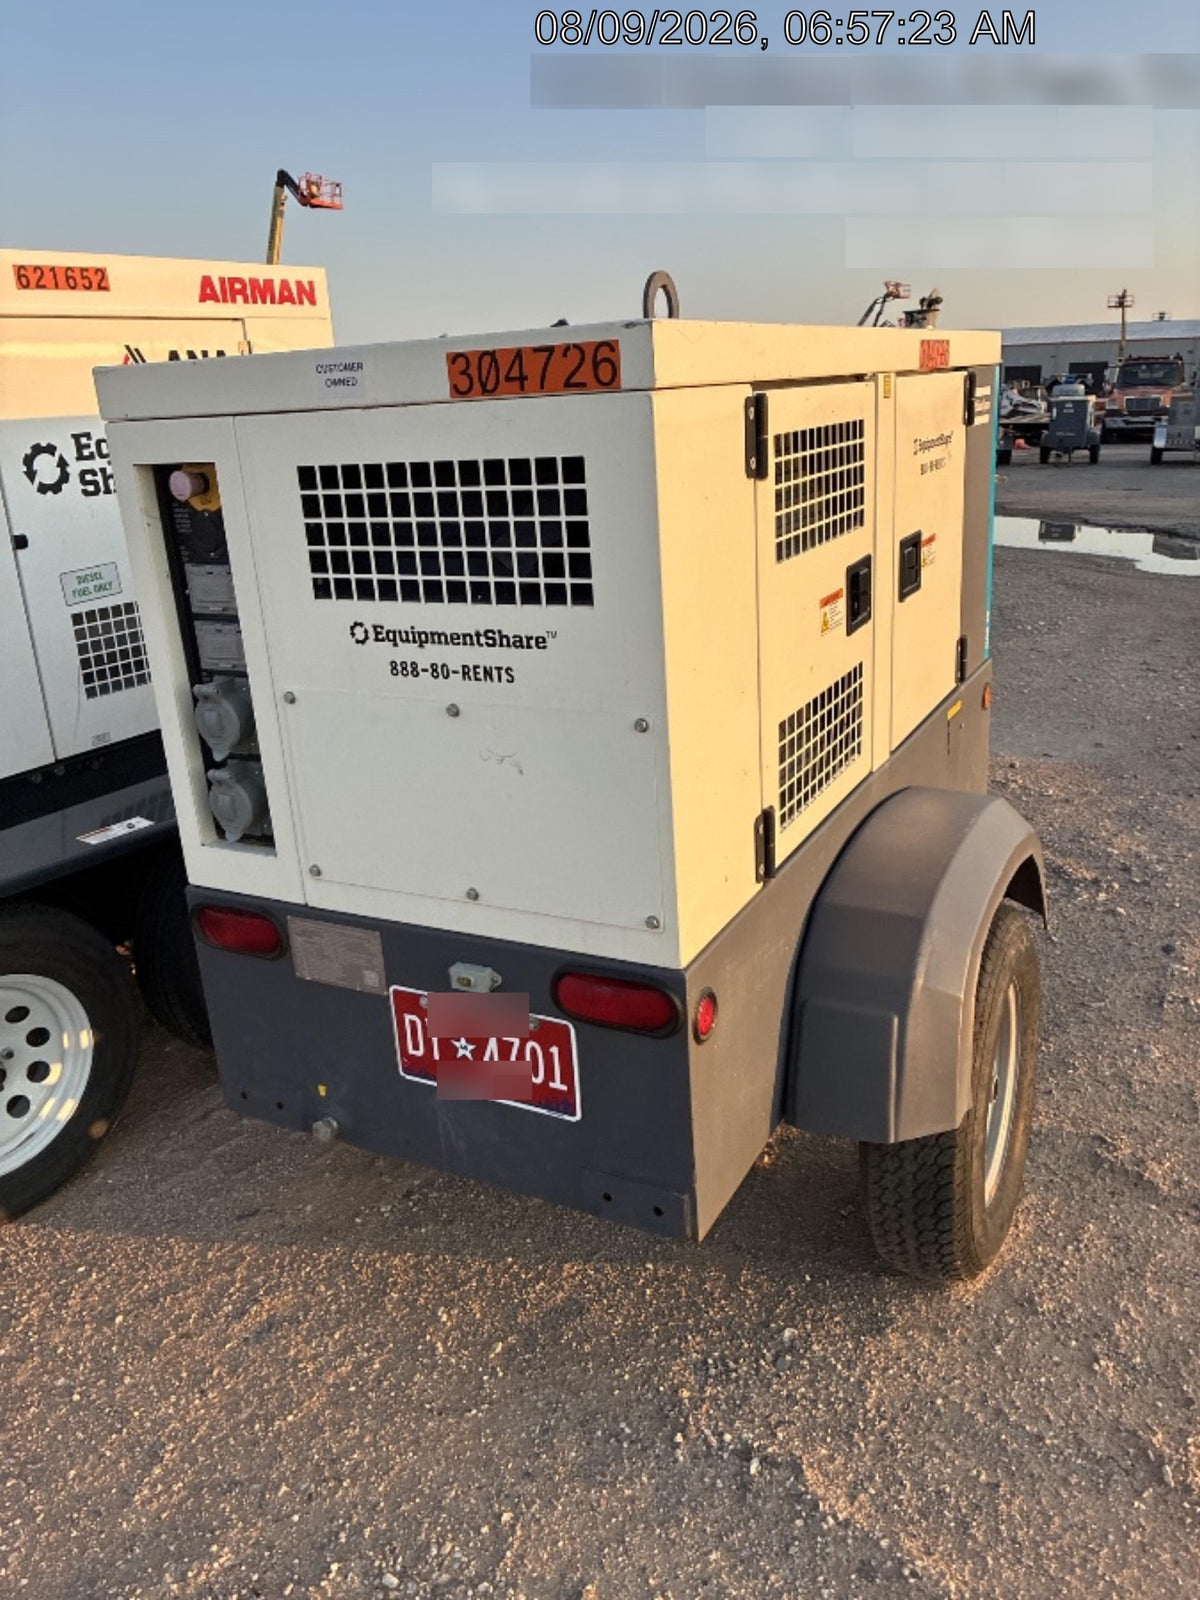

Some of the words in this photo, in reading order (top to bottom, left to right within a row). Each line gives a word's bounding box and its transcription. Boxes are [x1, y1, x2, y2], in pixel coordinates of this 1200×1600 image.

[16, 264, 107, 290] 621652
[199, 276, 317, 306] AIRMAN
[450, 340, 619, 397] 304726
[389, 660, 515, 684] 888-80-RENTS
